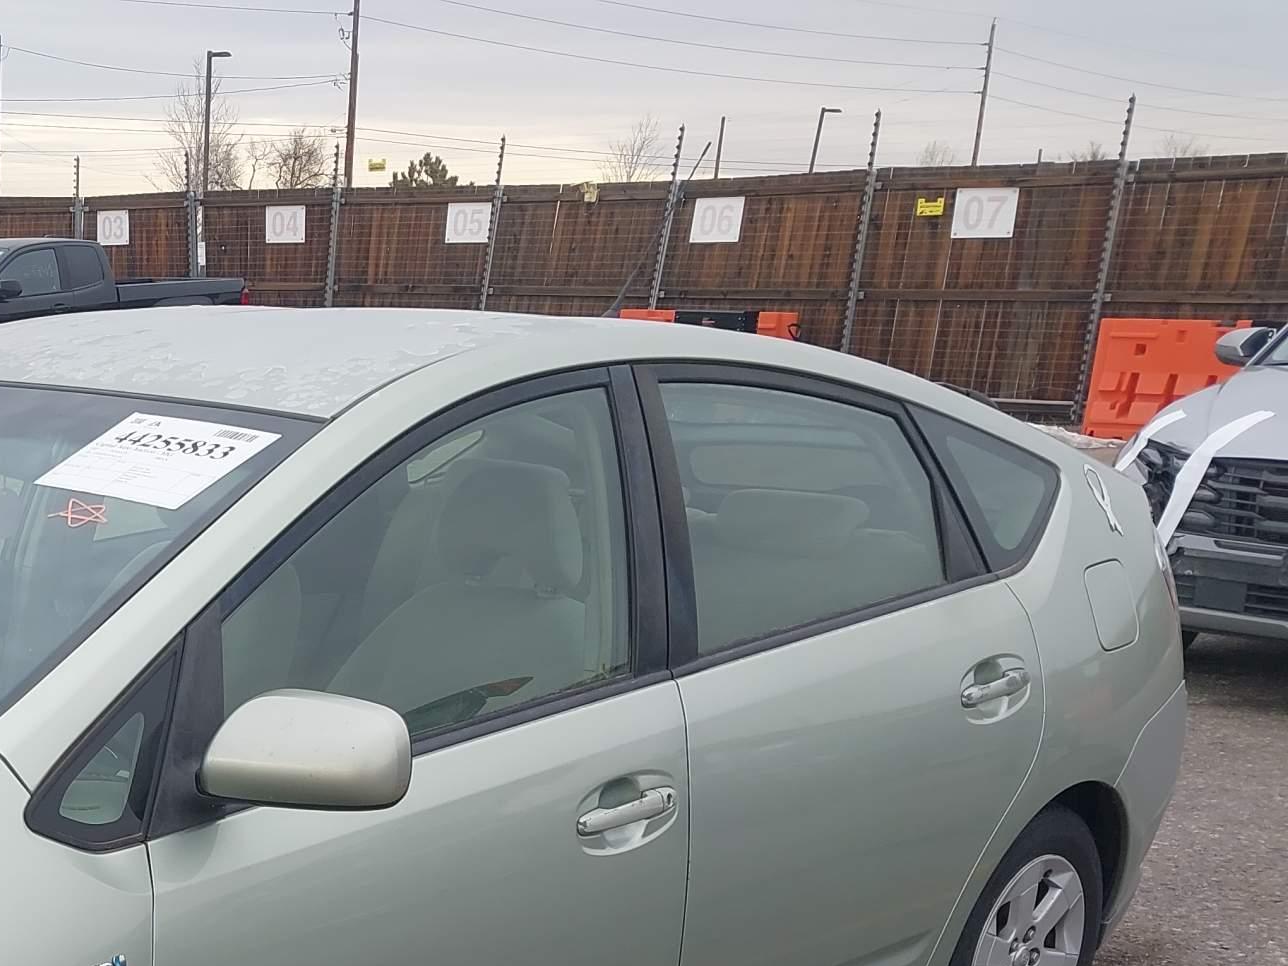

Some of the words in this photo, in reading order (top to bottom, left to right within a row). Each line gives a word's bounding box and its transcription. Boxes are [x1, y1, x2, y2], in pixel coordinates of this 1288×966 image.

[272, 211, 298, 237] 04
[454, 209, 484, 236] 05
[700, 205, 735, 235] 06
[963, 195, 1009, 230] 07
[103, 215, 124, 240] 03
[115, 430, 236, 460] 44255833
